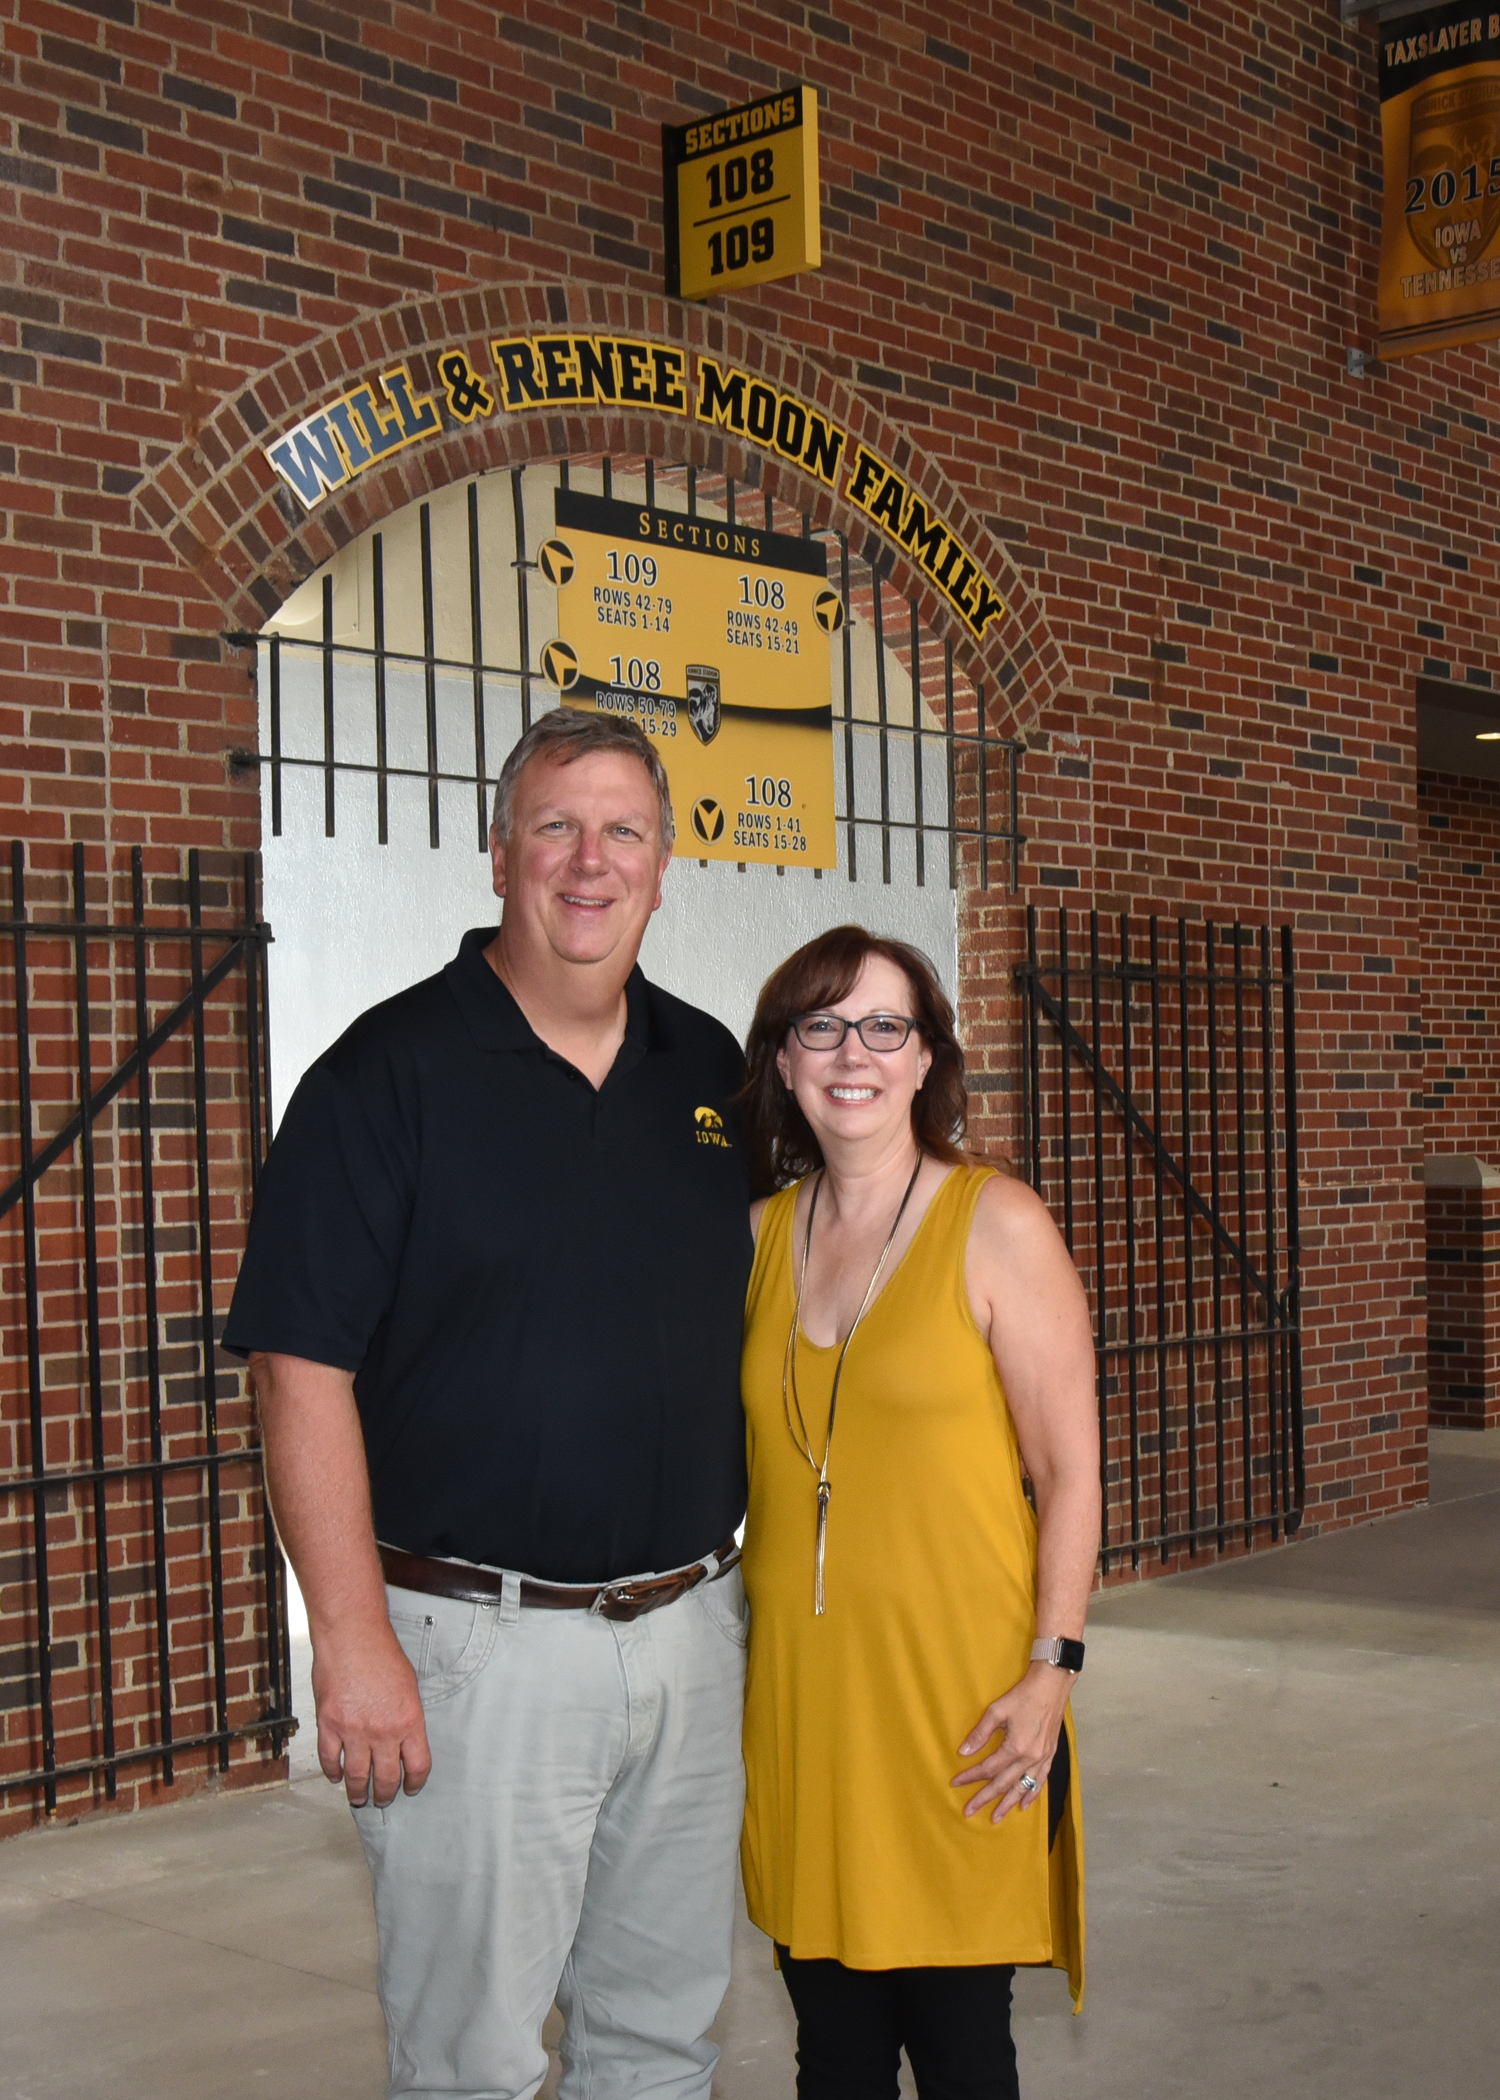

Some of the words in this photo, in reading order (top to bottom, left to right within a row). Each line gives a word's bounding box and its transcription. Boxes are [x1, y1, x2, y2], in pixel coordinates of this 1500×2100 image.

[1384, 18, 1482, 67] TAXSLAYER
[685, 95, 796, 155] SECTIONS
[706, 147, 774, 209] 108
[1404, 155, 1500, 214] 2015
[708, 217, 775, 276] 109
[1435, 218, 1481, 249] IOWA
[1449, 246, 1468, 264] VS
[264, 366, 443, 510] WILL
[437, 350, 494, 424] &
[490, 335, 687, 415] RENEE
[695, 355, 847, 488] MOON
[845, 443, 1006, 641] FAMILY
[606, 549, 658, 588] 109
[593, 585, 631, 608] ROWS
[635, 593, 672, 615] 42-79
[738, 574, 786, 611] 108
[597, 606, 637, 628] SEATS
[642, 613, 670, 633] 1-14
[727, 609, 761, 630] ROWS
[765, 616, 798, 636] 42-49
[727, 628, 763, 648] SEATS
[767, 635, 800, 655] 15-21
[609, 654, 662, 693] 108
[595, 690, 635, 713] ROWS
[638, 696, 677, 719] 50-79
[641, 717, 678, 738] 15-29
[745, 774, 793, 809] 108
[737, 811, 772, 831] ROWS
[776, 815, 802, 834] 1-41
[733, 829, 770, 849] SEATS
[774, 833, 807, 852] 15-28
[696, 1131, 729, 1147] IOWA
